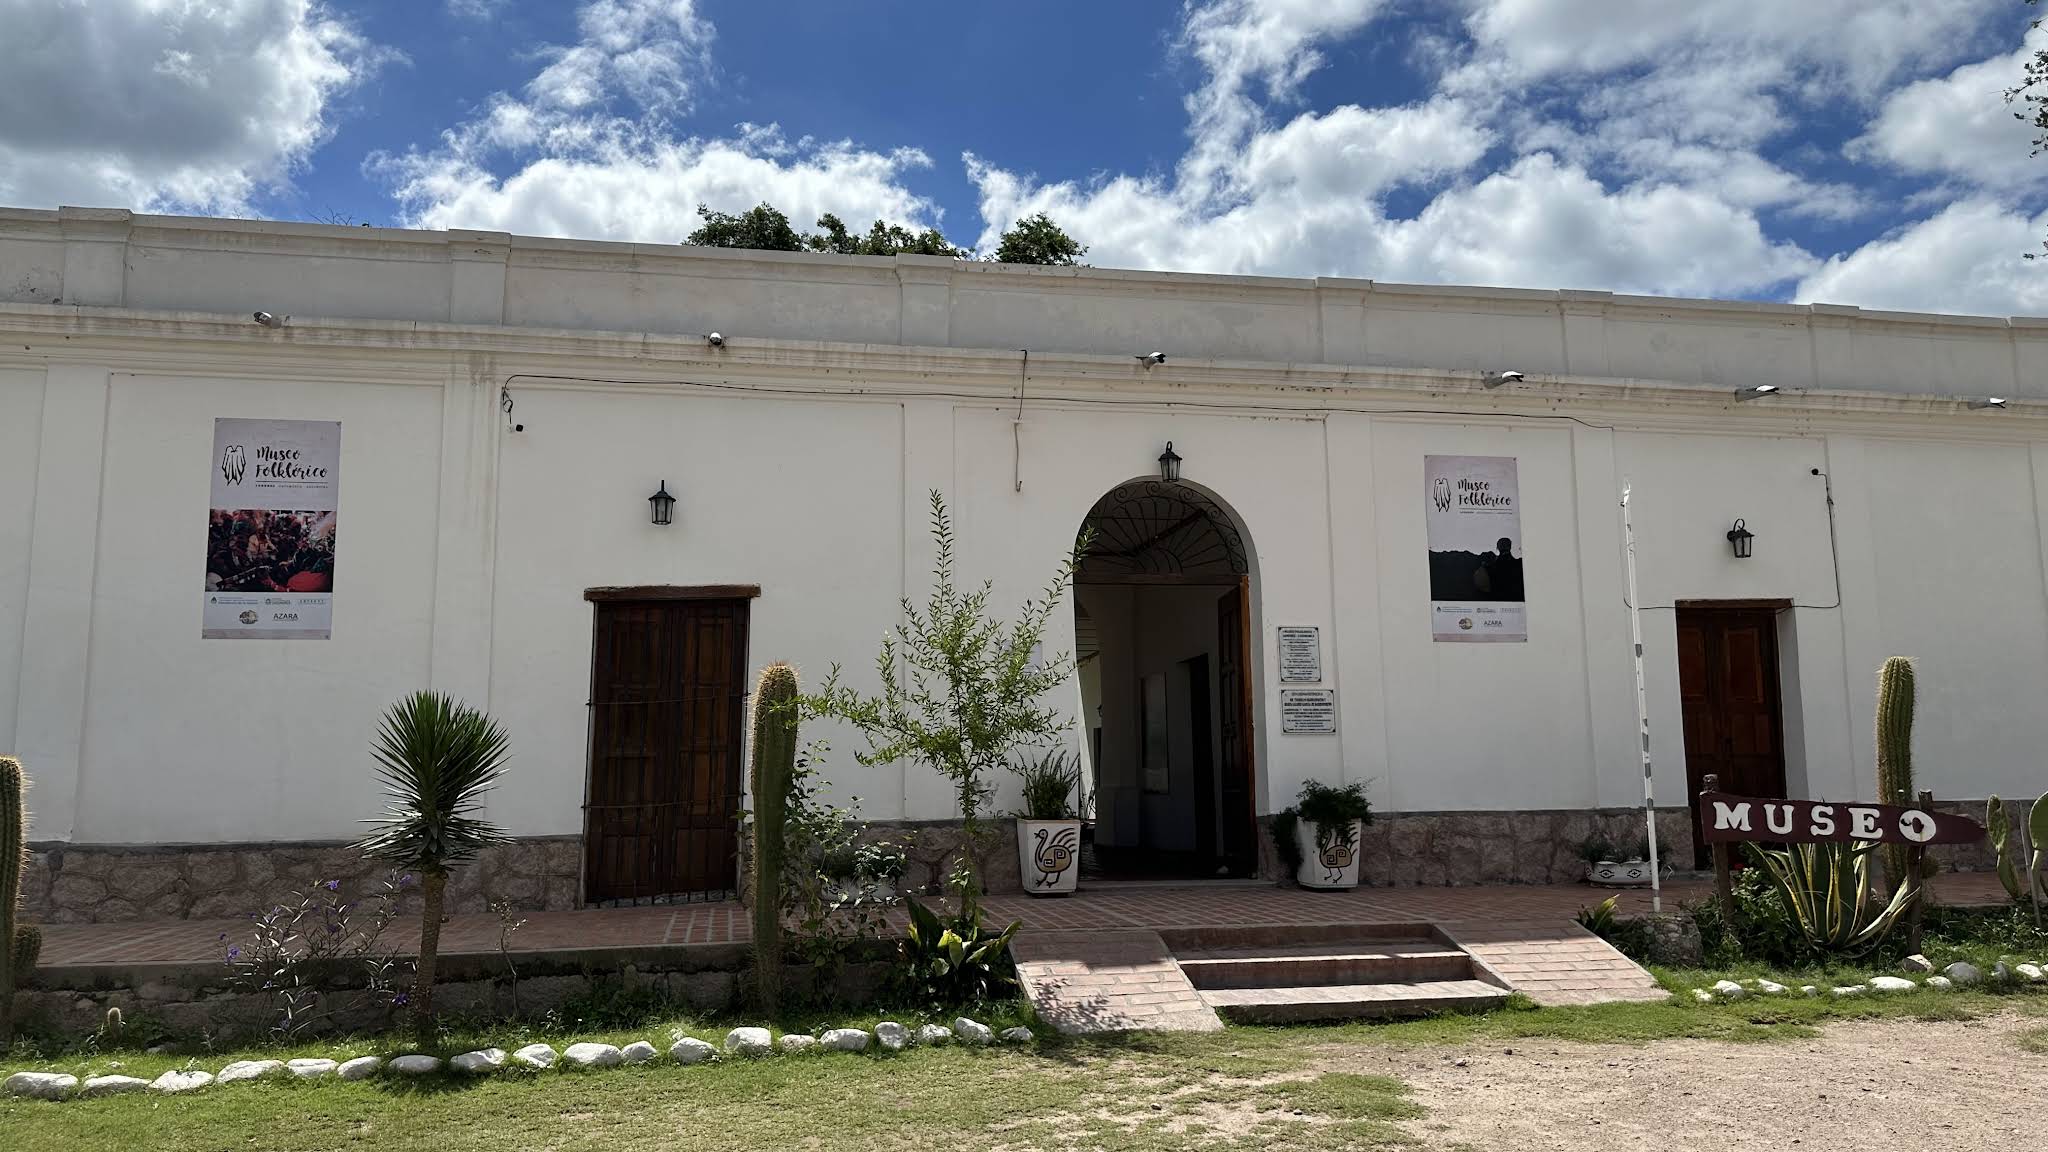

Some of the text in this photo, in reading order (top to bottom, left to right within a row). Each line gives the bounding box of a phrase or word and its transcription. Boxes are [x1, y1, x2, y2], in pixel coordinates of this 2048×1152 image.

[256, 446, 300, 461] Museo
[256, 462, 328, 479] Folklórico
[1457, 478, 1489, 492] Museo
[1458, 492, 1512, 507] Folklórico
[1712, 801, 1937, 842] MUSEO
